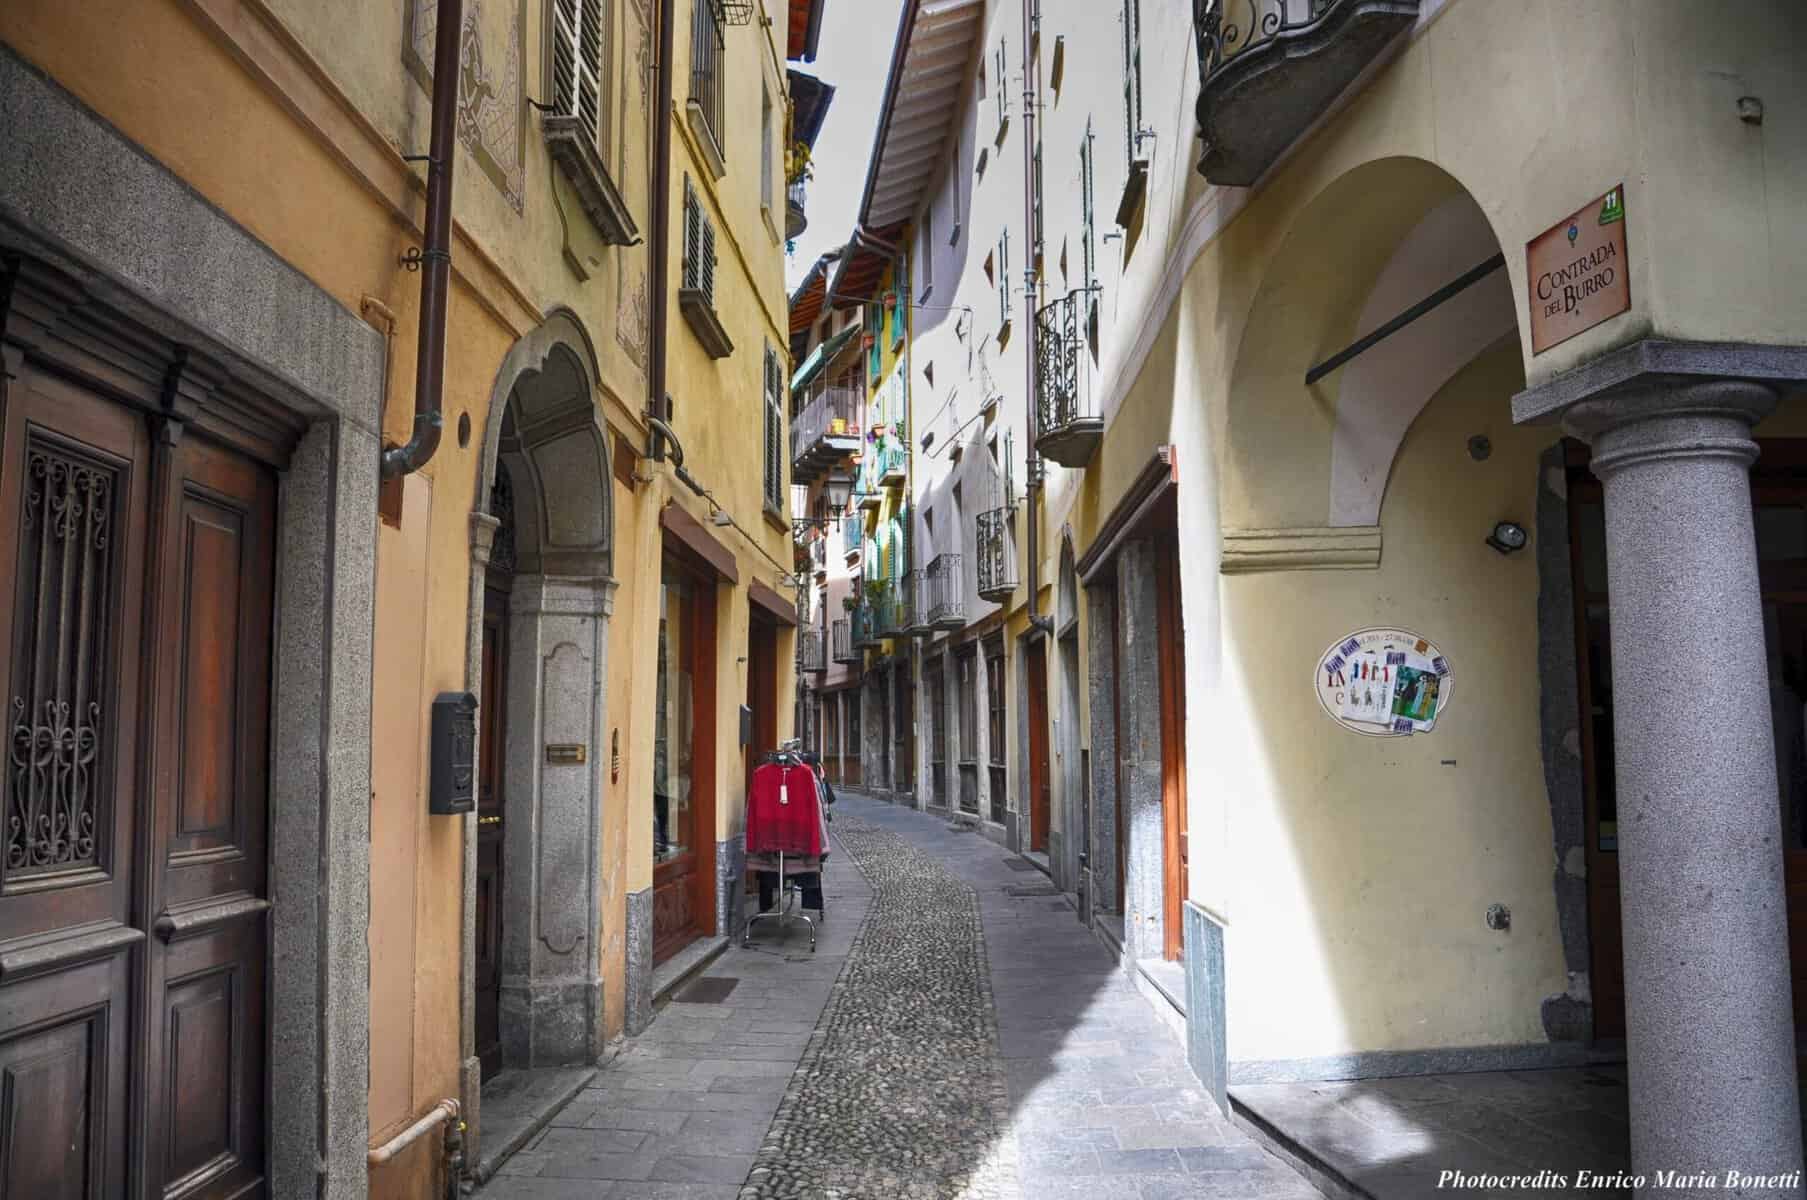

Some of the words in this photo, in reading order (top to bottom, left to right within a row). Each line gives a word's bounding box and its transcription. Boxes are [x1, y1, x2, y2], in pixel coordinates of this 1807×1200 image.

[1537, 241, 1616, 300] CONTRADA
[1544, 300, 1563, 318] DEL
[1563, 267, 1614, 313] BURRO
